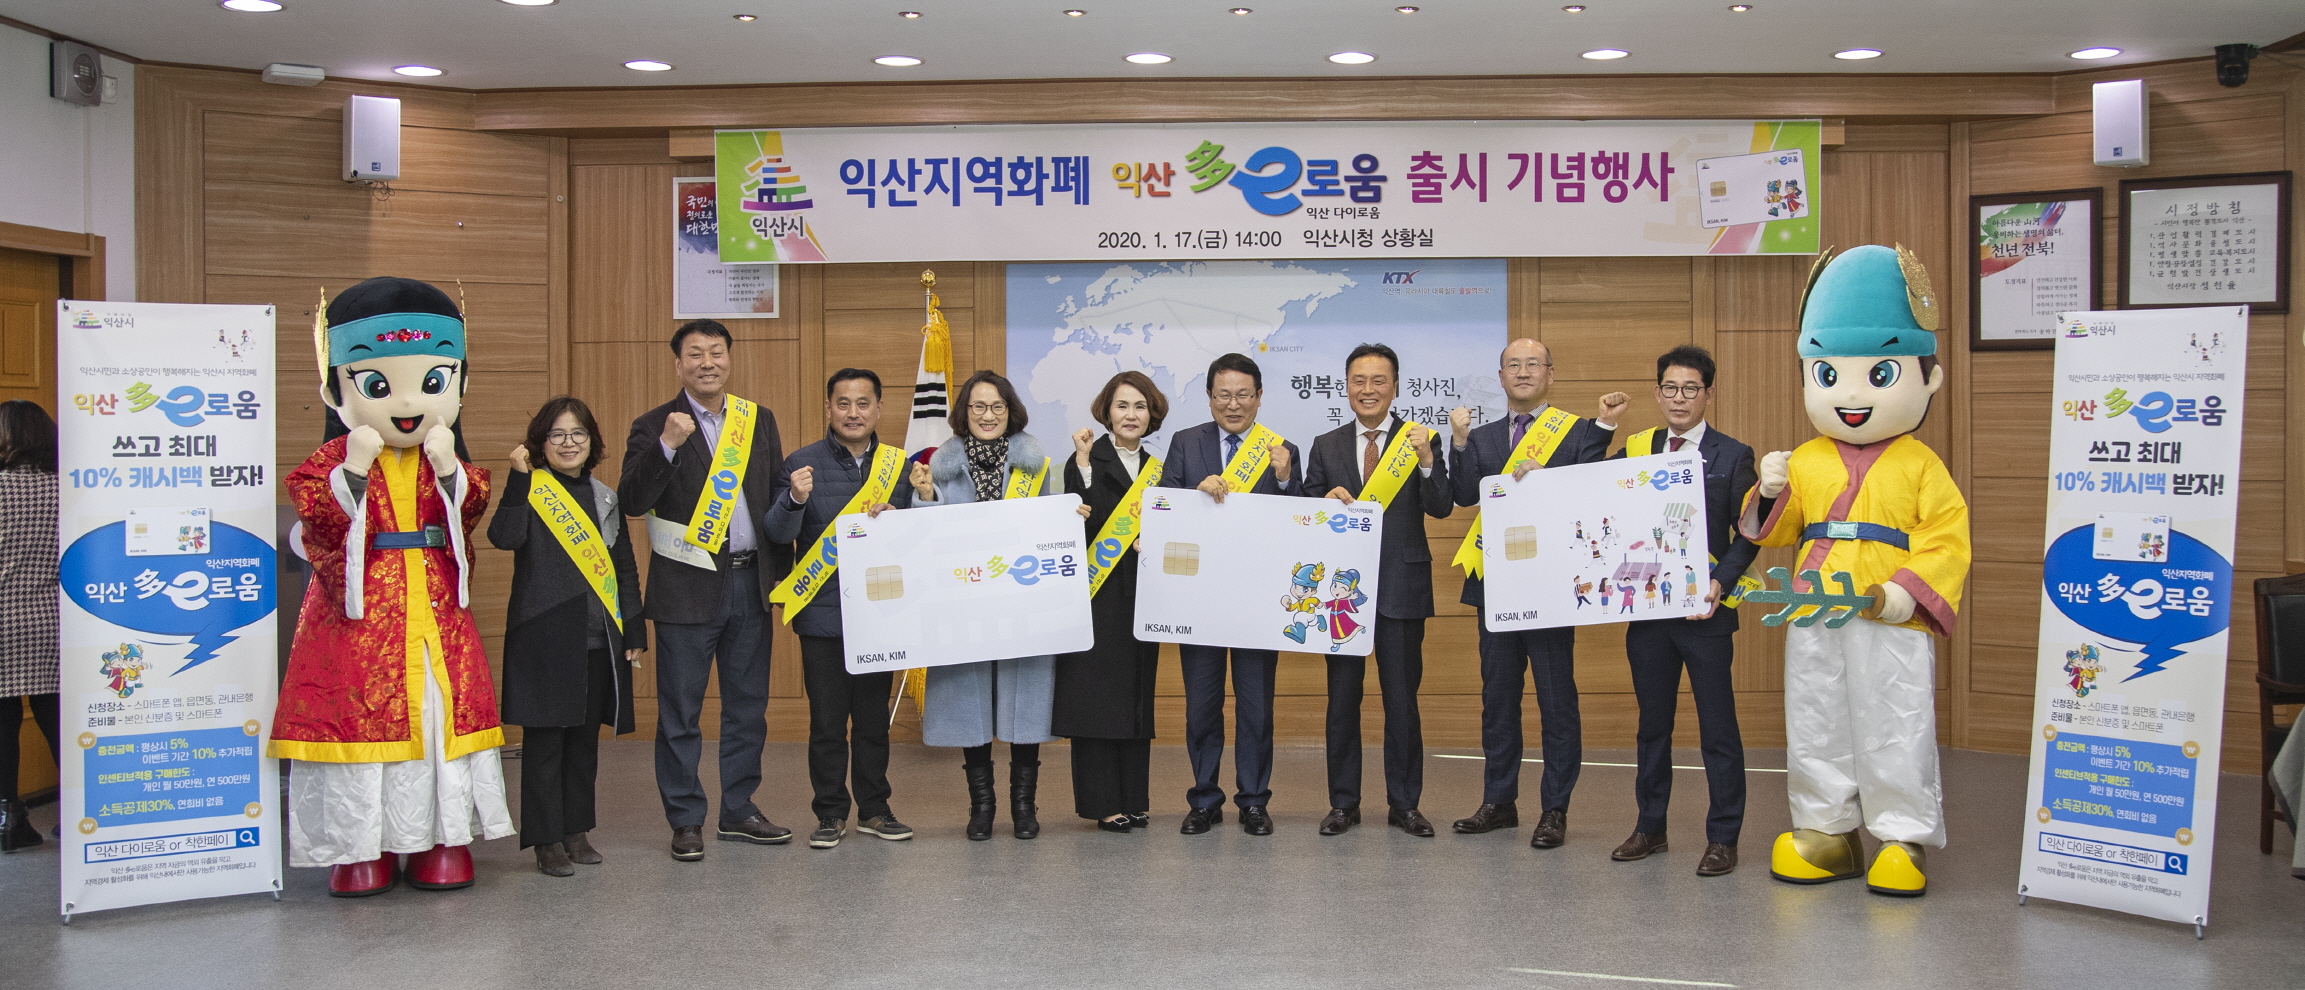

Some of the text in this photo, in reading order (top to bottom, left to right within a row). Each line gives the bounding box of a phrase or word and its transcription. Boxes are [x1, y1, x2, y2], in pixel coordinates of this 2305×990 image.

[839, 155, 1090, 208] 익산지역화폐
[1112, 162, 1175, 197] 익산
[1407, 150, 1675, 203] 출시 기념행사
[1306, 207, 1380, 219] 익산 다이로움
[753, 216, 805, 238] 익산시
[1993, 219, 2021, 227] 아름다운
[1098, 232, 1147, 249] 2020.
[1155, 232, 1167, 248] 1.
[1236, 231, 1282, 248] 14:00
[1303, 230, 1373, 248] 익산시청
[1381, 229, 1433, 248] 상황실
[1992, 242, 2054, 258] 천년 전북!
[1382, 269, 1422, 284] KTX
[104, 317, 134, 328] 익산시
[2090, 325, 2116, 336] 익산시
[80, 367, 257, 377] 익산시민과 소상공인이 행복해지는 익산시 지역화폐
[2068, 372, 2225, 383] 익산시민과 소상공인이 행복해지는 익산시 지역화폐
[1408, 377, 1461, 400] 청사진,
[74, 393, 118, 416] 익산
[2062, 400, 2097, 421] 익산
[730, 415, 747, 448] 익산
[113, 435, 216, 457] 쓰고 최대
[1526, 431, 1552, 458] 익산
[2089, 441, 2181, 464] 쓰고 최대
[69, 465, 263, 489] 10% 캐시백 받자!
[1617, 478, 1634, 489] 익산
[2055, 471, 2224, 496] 10% 캐시백 받자!
[1293, 515, 1311, 526] 익산
[534, 484, 607, 577] 익산지역화폐 익산
[1036, 540, 1077, 551] 익산지역화폐
[206, 558, 260, 569] 익산지역화폐
[954, 566, 982, 583] 익산
[2162, 568, 2213, 581] 익산지역화폐
[86, 582, 127, 603] 익산
[2058, 582, 2092, 604] 익산
[1495, 610, 1538, 622] IKSAN, KIM
[1145, 624, 1192, 635] IKSAN, KIM
[856, 651, 906, 664] IKSAN, KIM
[88, 701, 125, 713] 신청장소
[134, 699, 170, 710] 스마트폰
[218, 692, 254, 704] 관내은행
[2052, 698, 2081, 710] 신청장소
[2088, 701, 2119, 714] 스마트폰
[2161, 709, 2195, 723] 관내은행
[88, 708, 223, 727] 준비물 본인 신분증 및 스마트폰
[2050, 712, 2164, 734] 준비물 본인 신분증 및 스마트폰
[98, 738, 188, 756] 충전금액 평상시 5%
[143, 746, 253, 764] 이벤트 기간 10% 추가적립
[2056, 741, 2131, 759] 충전금액 평상시 5%
[98, 768, 190, 784] 인센티브적용 구매한도
[2091, 757, 2189, 778] 이벤트 기간 10% 추가적립
[143, 774, 251, 792] 개인 월 50만원, 연 500만원
[2055, 768, 2130, 787] 인센티브적용 구매한도
[178, 798, 204, 809] 연회비
[206, 796, 224, 807] 없음
[2089, 785, 2104, 796] 개인
[2106, 787, 2113, 797] 월
[2143, 792, 2151, 802] 연
[2153, 793, 2184, 807] 500만원
[2116, 809, 2139, 822] 연회비
[2141, 812, 2157, 824] 없음
[95, 833, 229, 857] 익산 다이로움 or 착한페이
[2047, 837, 2158, 866] 익산 다이로움 or 착한페이
